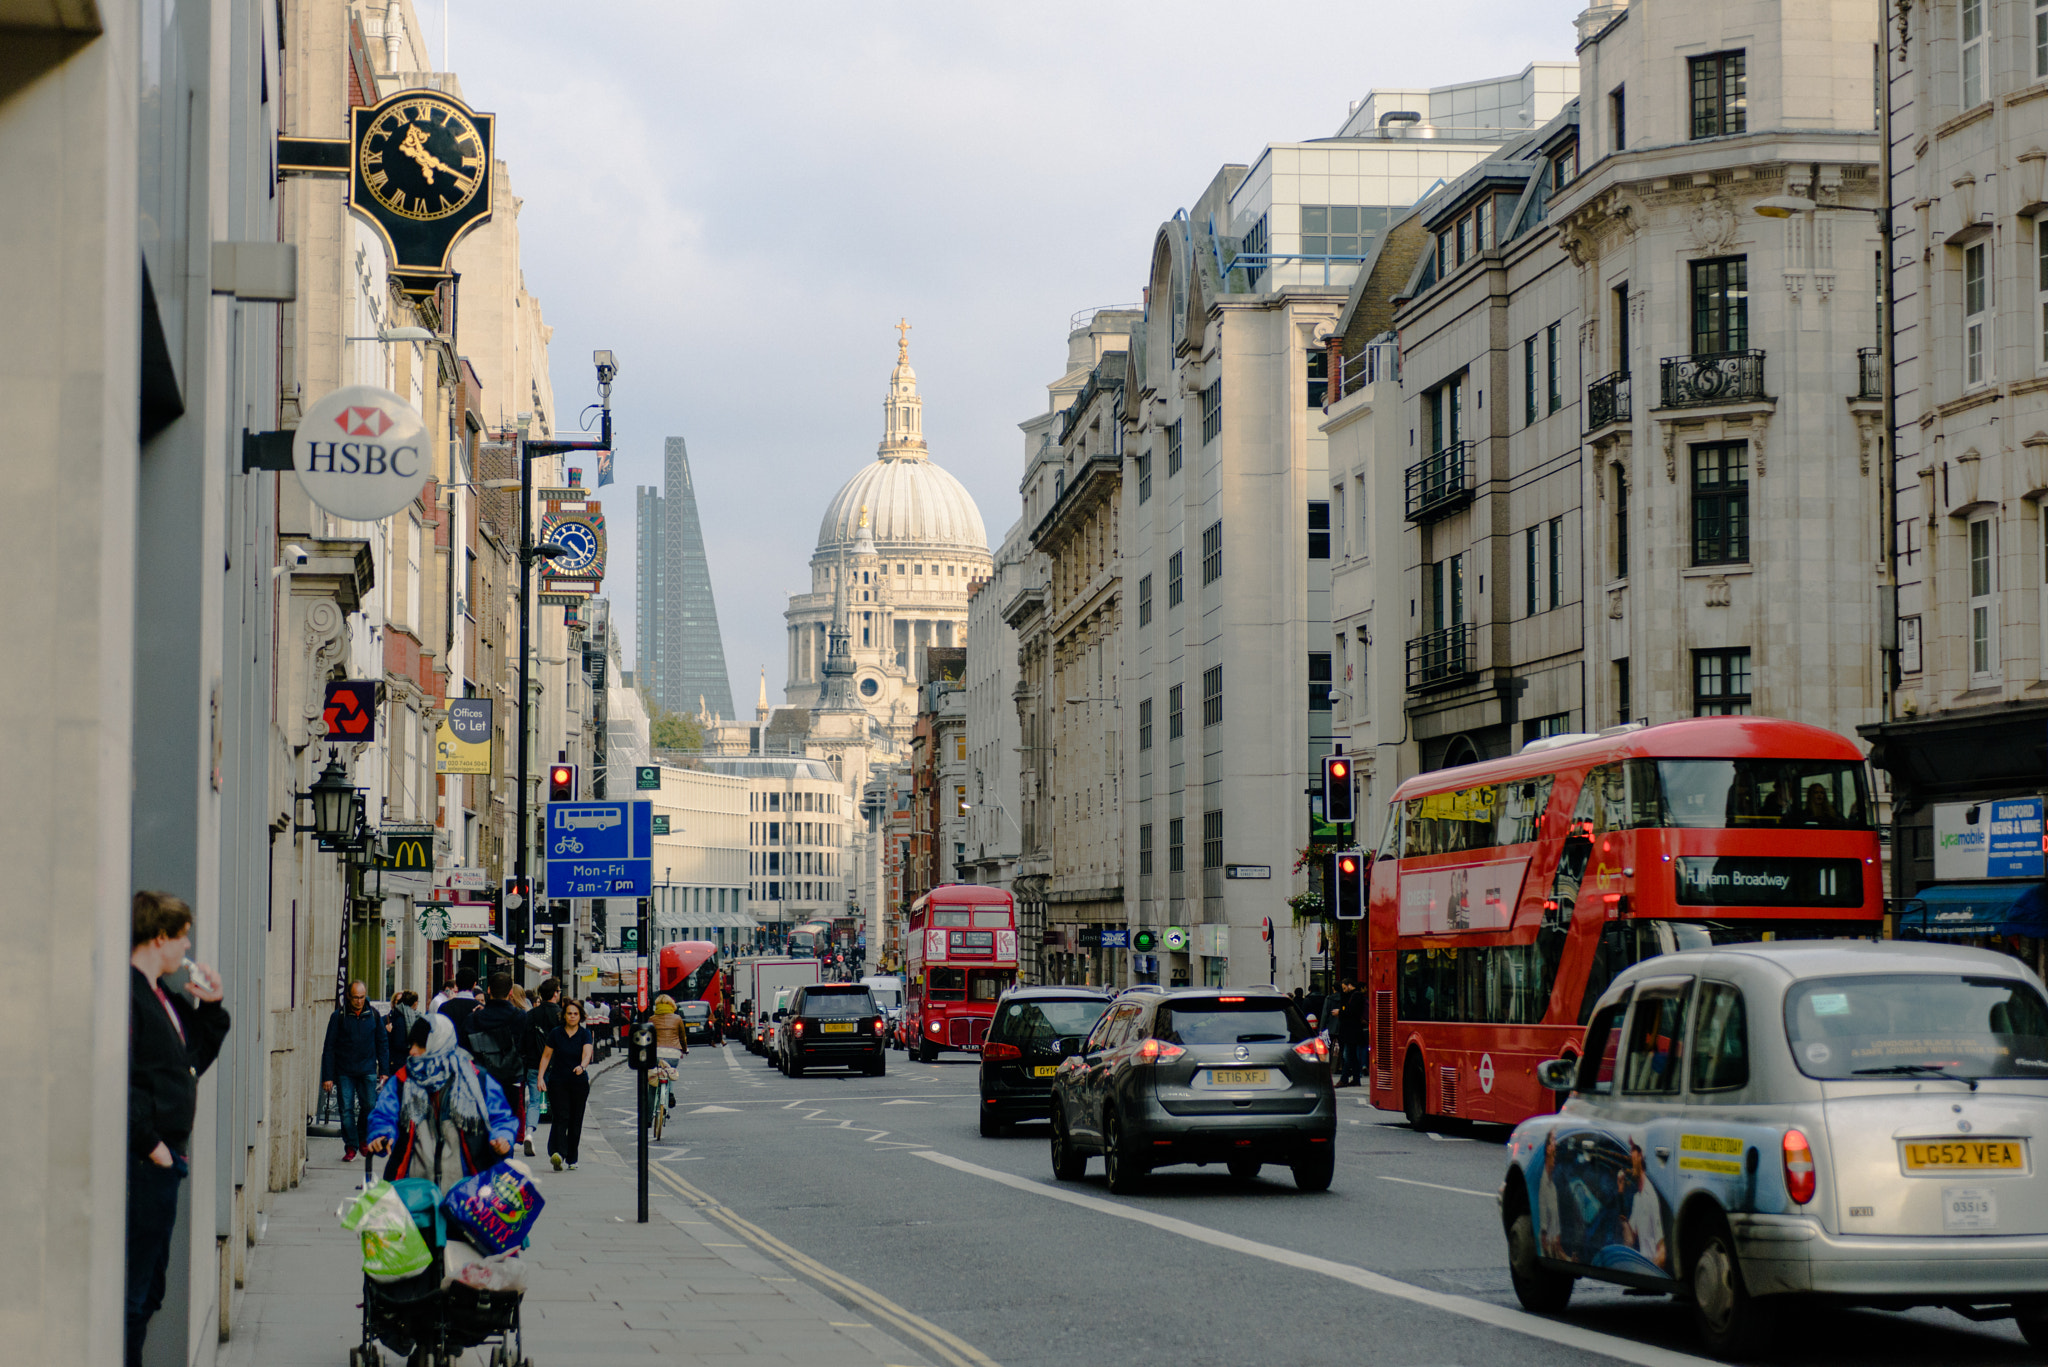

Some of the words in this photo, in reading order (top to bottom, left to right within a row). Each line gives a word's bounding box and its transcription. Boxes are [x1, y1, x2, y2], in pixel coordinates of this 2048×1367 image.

[306, 441, 418, 478] HSBC
[453, 708, 483, 718] Offices
[453, 719, 466, 731] To
[469, 719, 487, 731] Let
[1998, 804, 2035, 820] RADFORD
[1991, 821, 2013, 835] NEWS
[2013, 820, 2020, 834] &
[2020, 819, 2042, 834] WINE
[1940, 828, 1985, 850] Lycamobile
[1686, 869, 1729, 885] Fulham
[1732, 871, 1790, 890] Broadway
[1819, 868, 1837, 896] 11
[952, 934, 961, 944] 15
[1172, 968, 1187, 978] 70
[1217, 1071, 1242, 1083] ET16
[1244, 1071, 1267, 1082] XFJ
[1912, 1144, 1968, 1164] LG52
[1973, 1144, 2013, 1163] VEA
[1952, 1201, 1988, 1213] 03515
[465, 1196, 514, 1243] COUNTS
